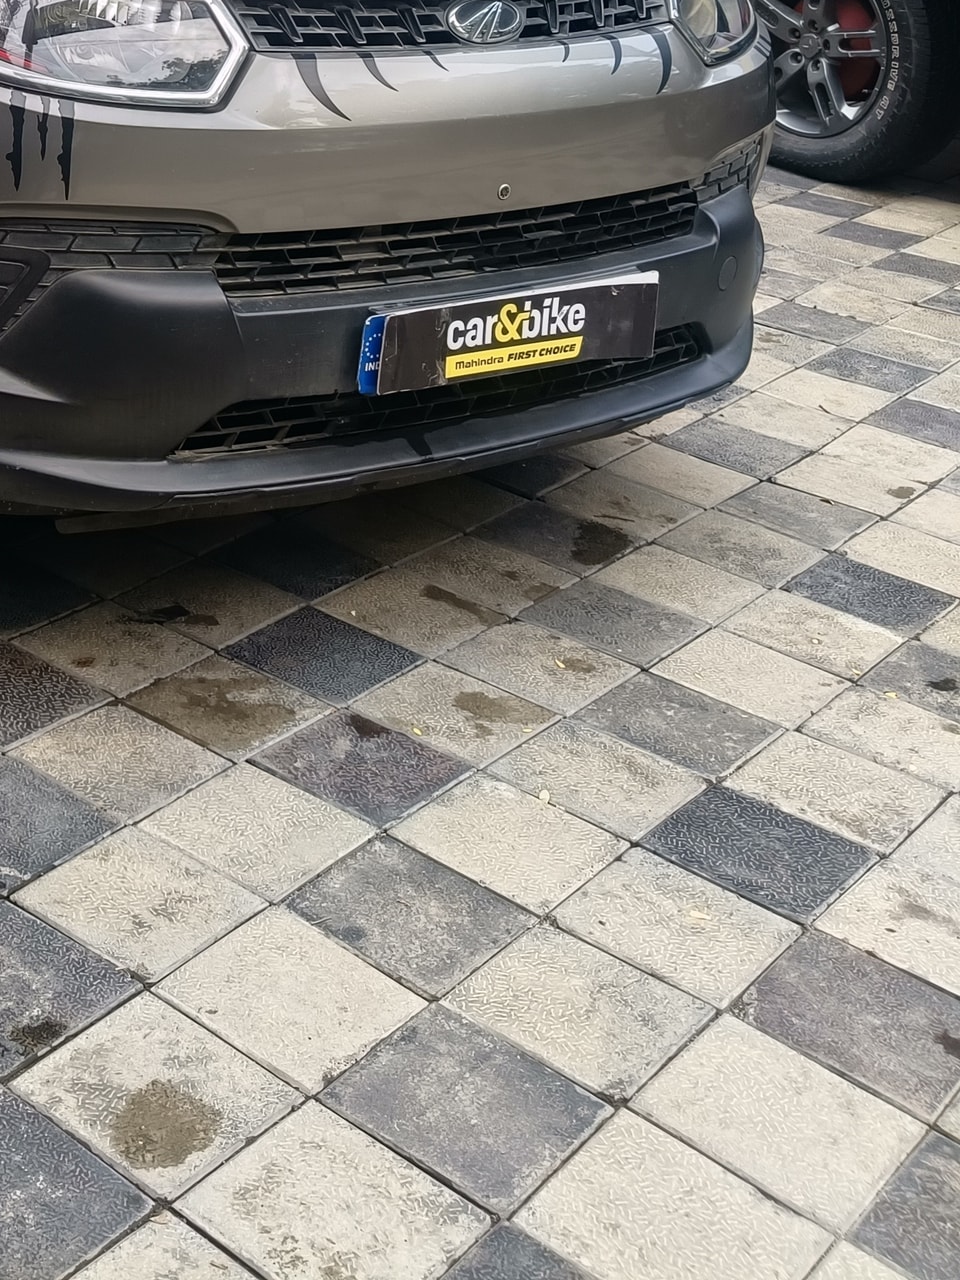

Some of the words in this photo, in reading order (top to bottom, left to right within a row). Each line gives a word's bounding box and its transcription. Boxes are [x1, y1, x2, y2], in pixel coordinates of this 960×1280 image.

[446, 297, 586, 350] car&bike
[455, 356, 504, 370] Mahindra
[506, 349, 538, 362] FIRST
[539, 343, 577, 357] CHOICE
